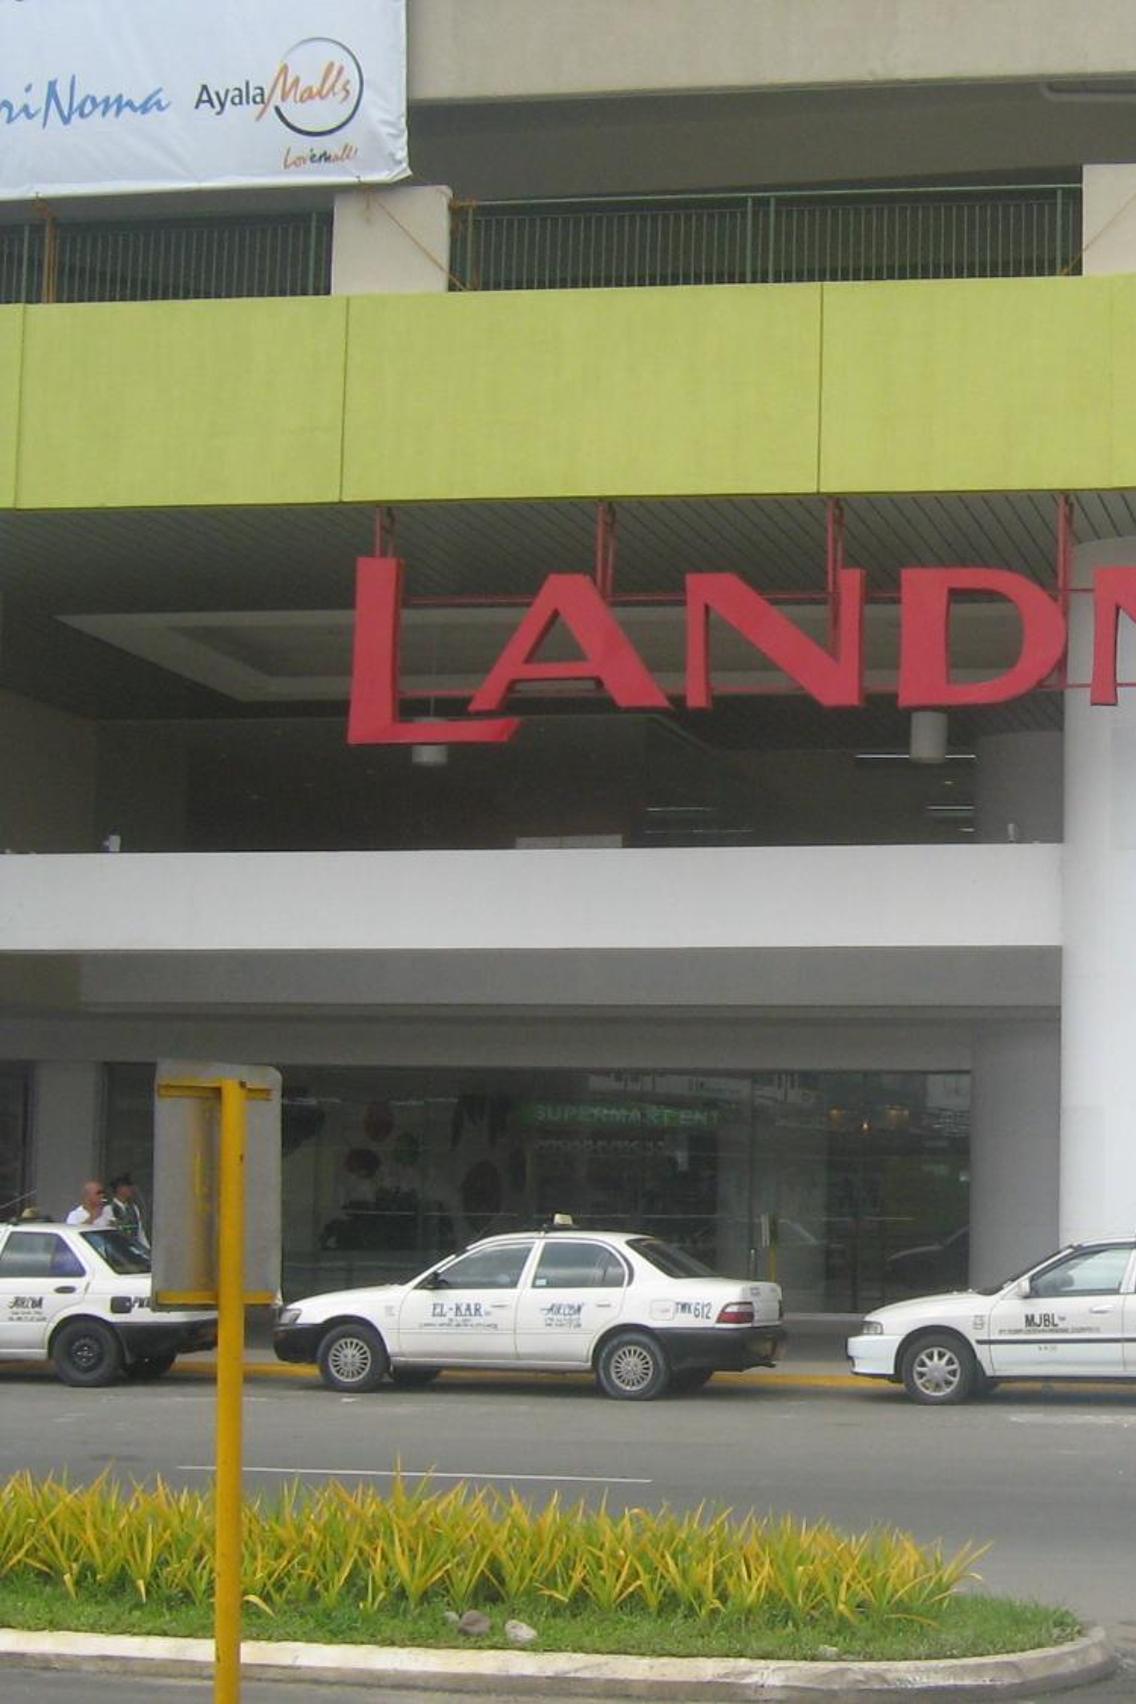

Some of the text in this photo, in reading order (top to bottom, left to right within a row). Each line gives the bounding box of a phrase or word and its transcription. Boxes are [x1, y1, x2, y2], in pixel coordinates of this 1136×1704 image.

[194, 61, 351, 122] Ayala Malls
[431, 1302, 483, 1318] EL-KAR
[1024, 1313, 1059, 1328] MJBL
